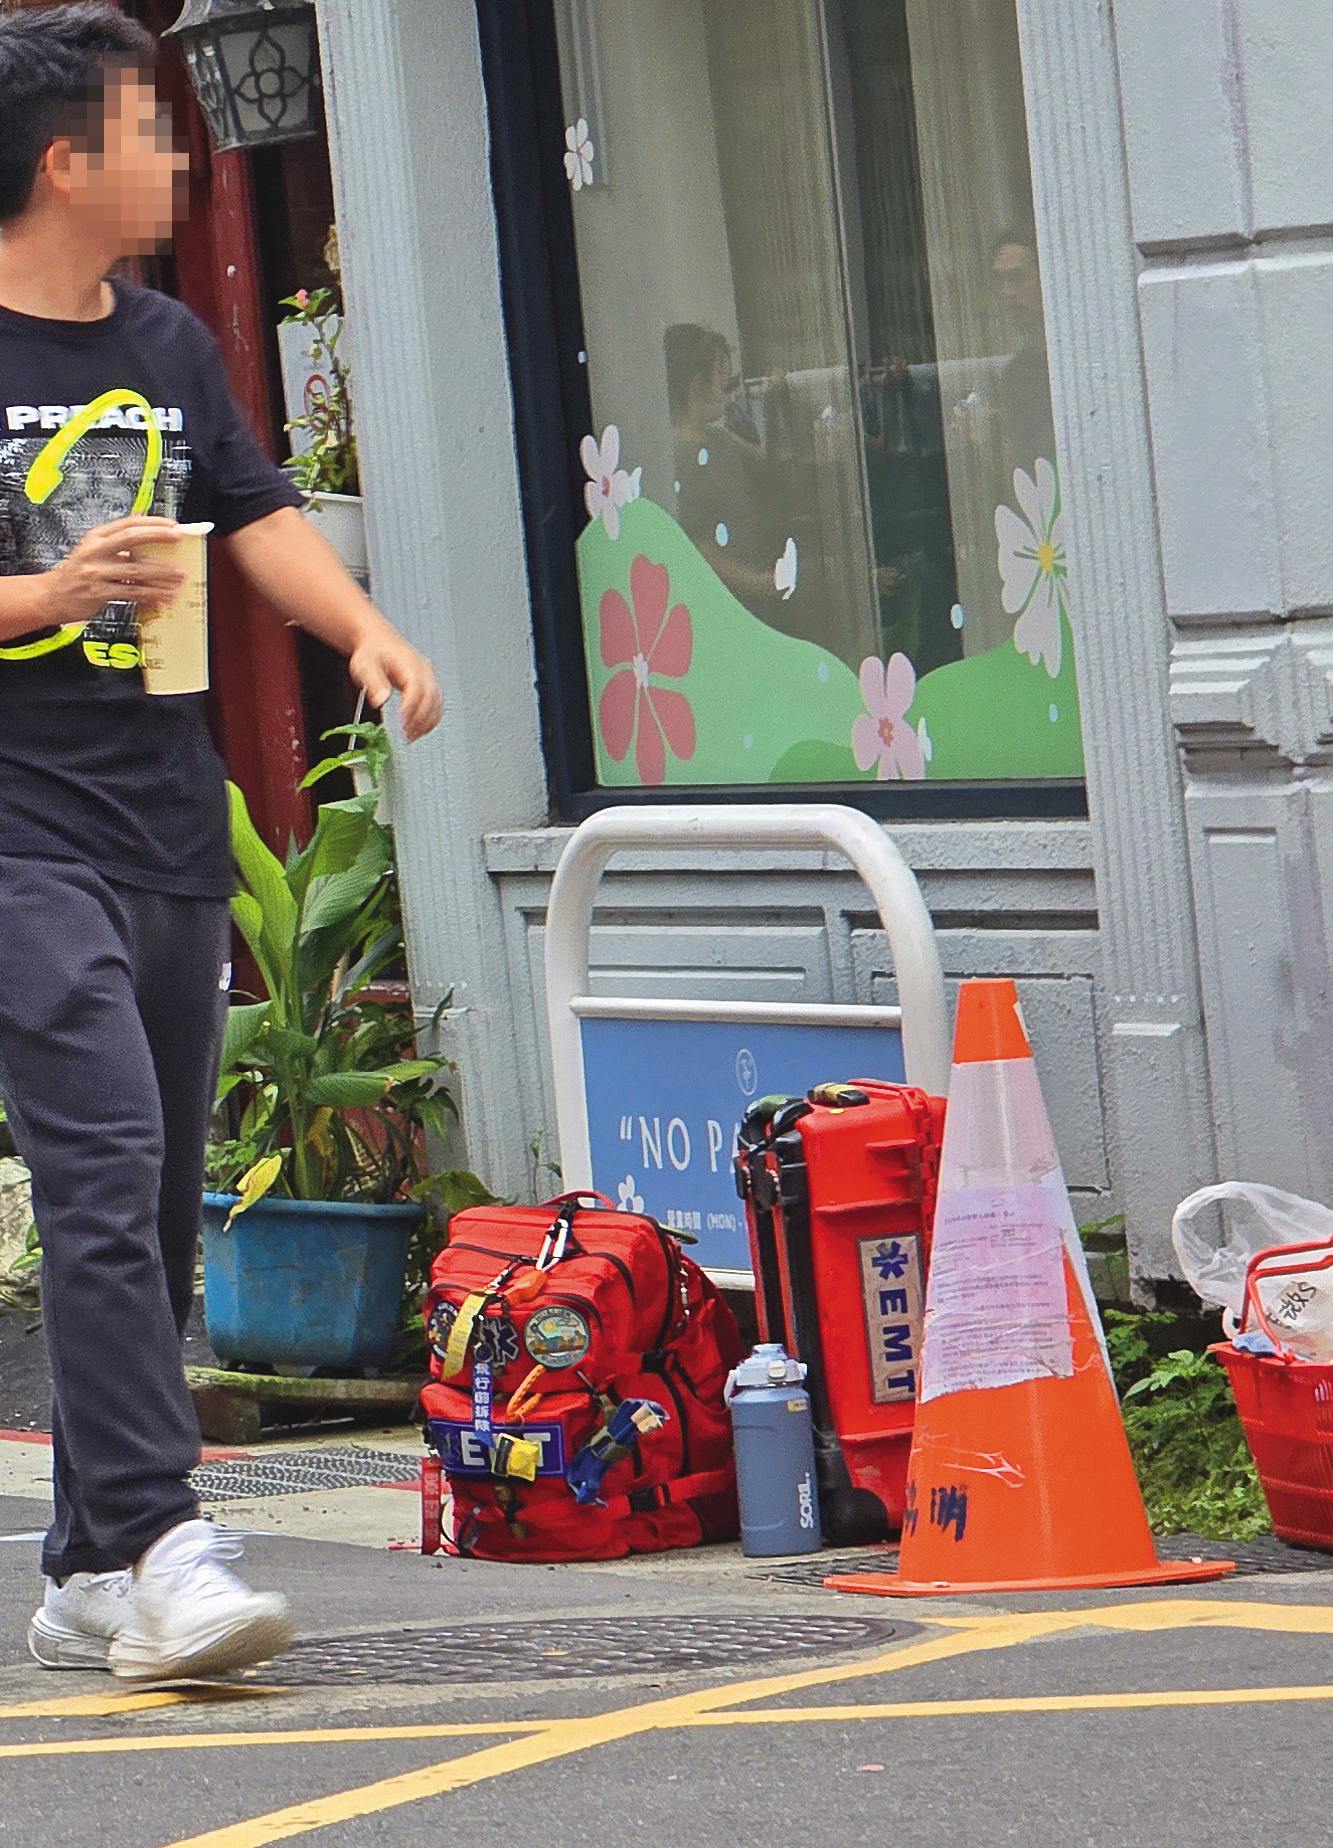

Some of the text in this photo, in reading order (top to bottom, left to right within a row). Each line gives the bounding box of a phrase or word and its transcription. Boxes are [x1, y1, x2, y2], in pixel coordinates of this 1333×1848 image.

[83, 641, 148, 669] ES
[878, 1288, 917, 1393] EMT
[460, 1431, 552, 1467] ET
